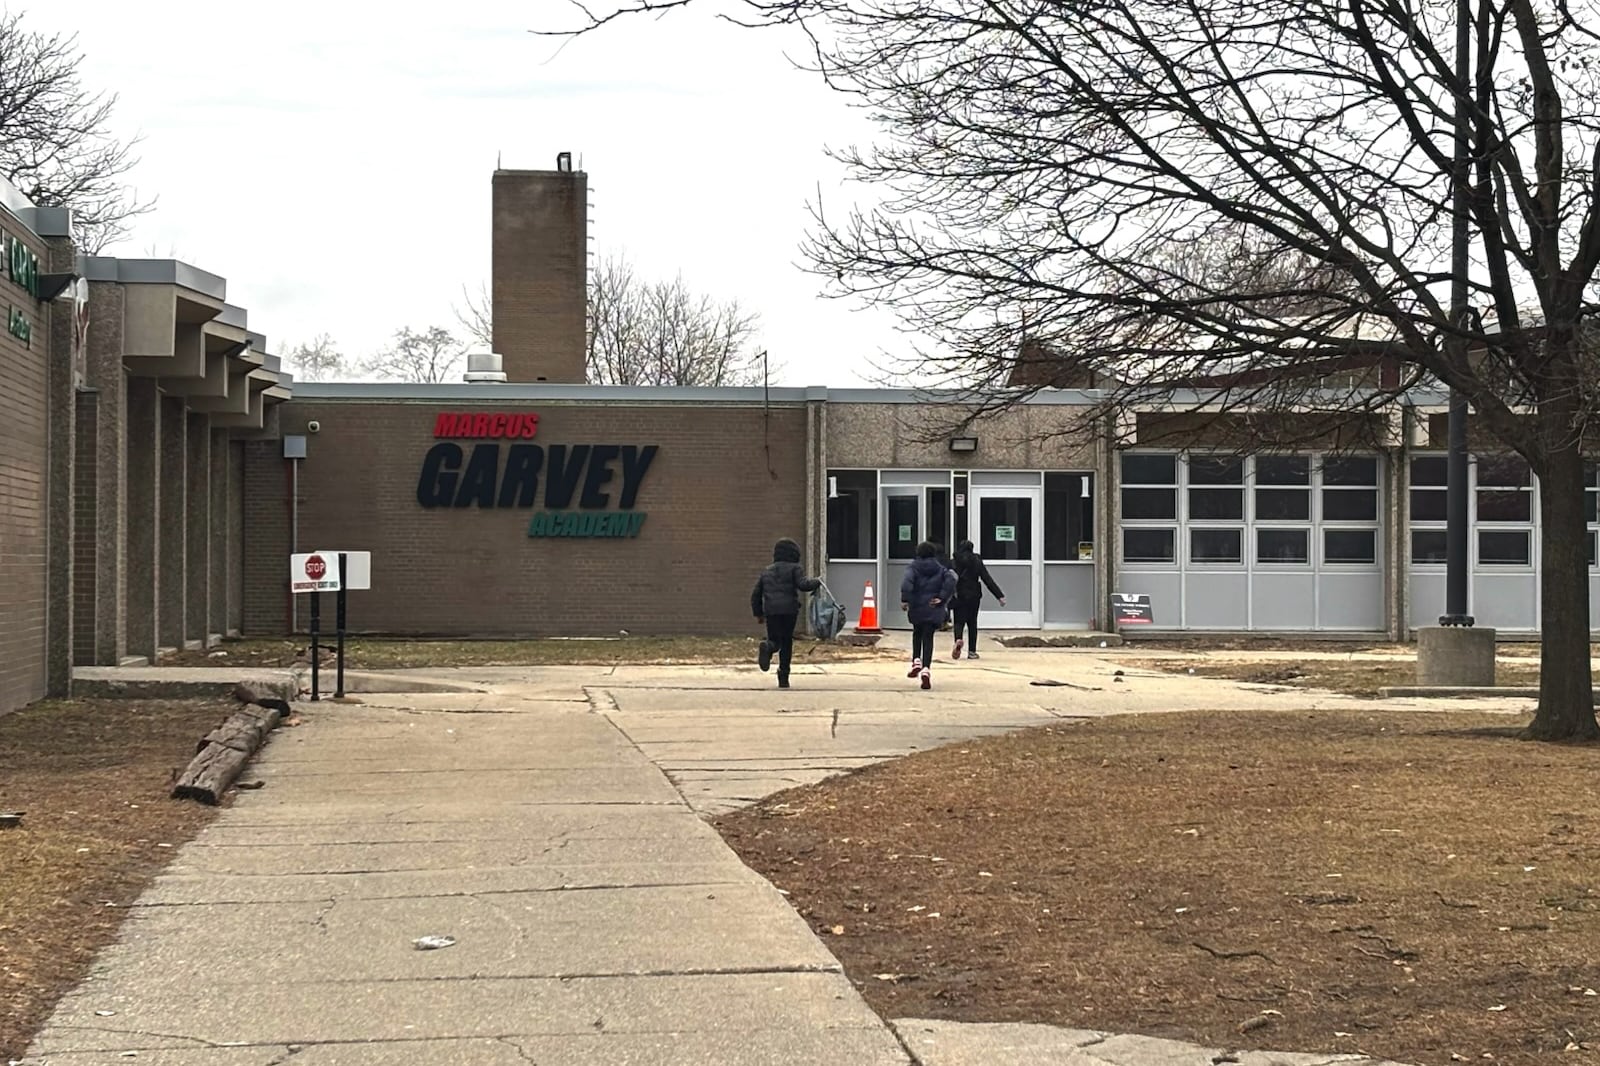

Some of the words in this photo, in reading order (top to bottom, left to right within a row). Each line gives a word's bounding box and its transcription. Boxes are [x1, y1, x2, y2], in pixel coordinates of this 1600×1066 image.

[433, 412, 539, 439] MARCUS
[417, 442, 659, 509] GARVEY
[528, 512, 647, 538] ACADEMY
[306, 563, 325, 573] STOP
